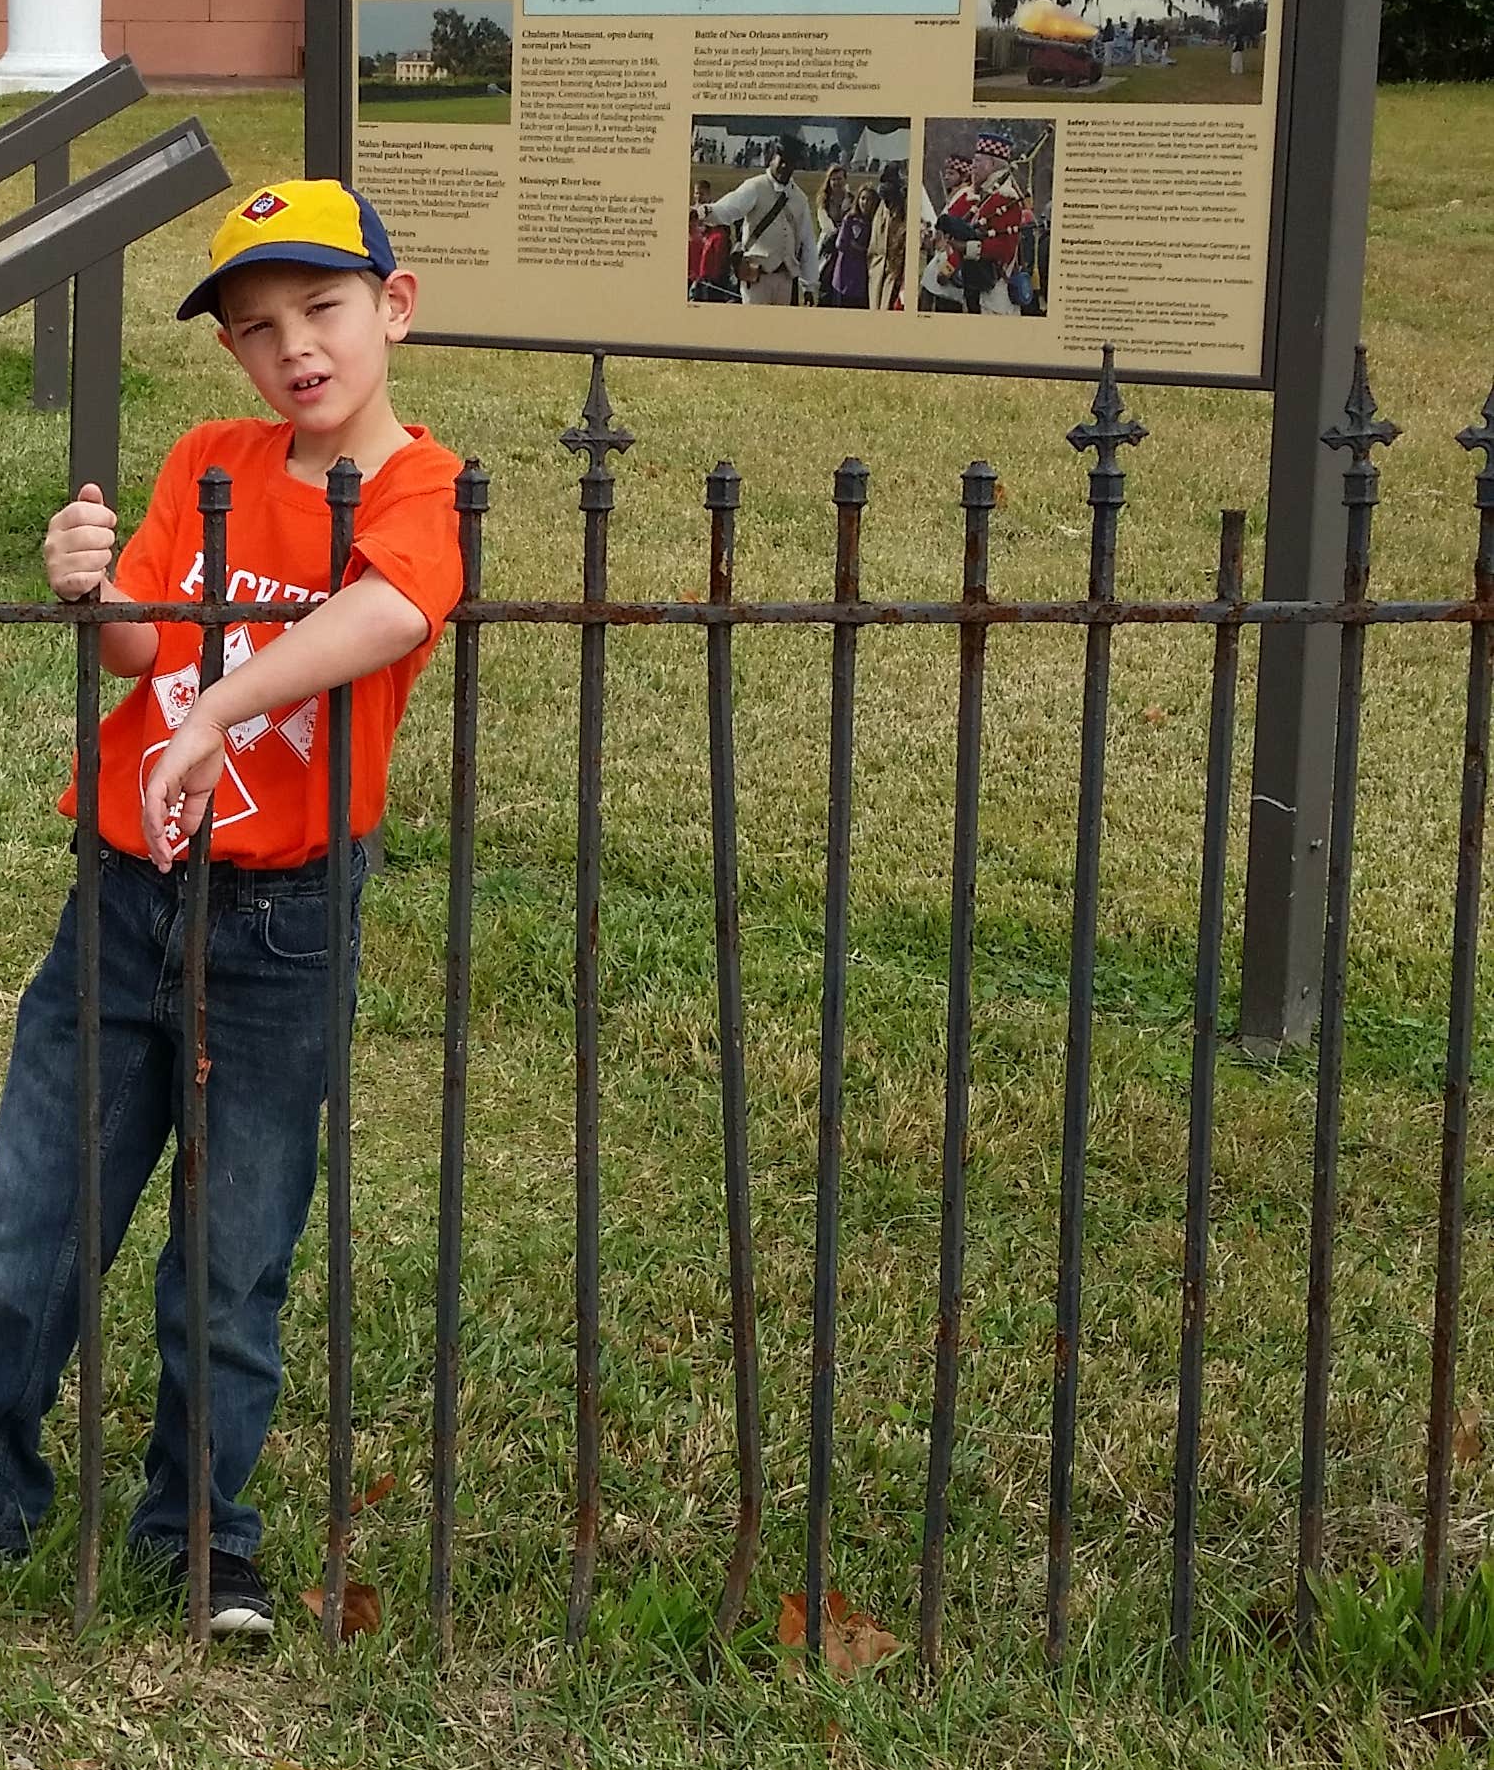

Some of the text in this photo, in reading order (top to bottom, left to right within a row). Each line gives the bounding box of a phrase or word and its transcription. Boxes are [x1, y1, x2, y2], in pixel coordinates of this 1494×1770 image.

[521, 30, 560, 39] Chalmette
[606, 33, 627, 41] open
[627, 31, 654, 41] during
[694, 30, 829, 41] Battle of New Orleans anniversary
[521, 41, 592, 52] normal park hours
[449, 144, 468, 152] open
[468, 142, 494, 153] during
[358, 150, 423, 161] normal park hours
[519, 177, 560, 188] Mississippi
[560, 177, 581, 186] River
